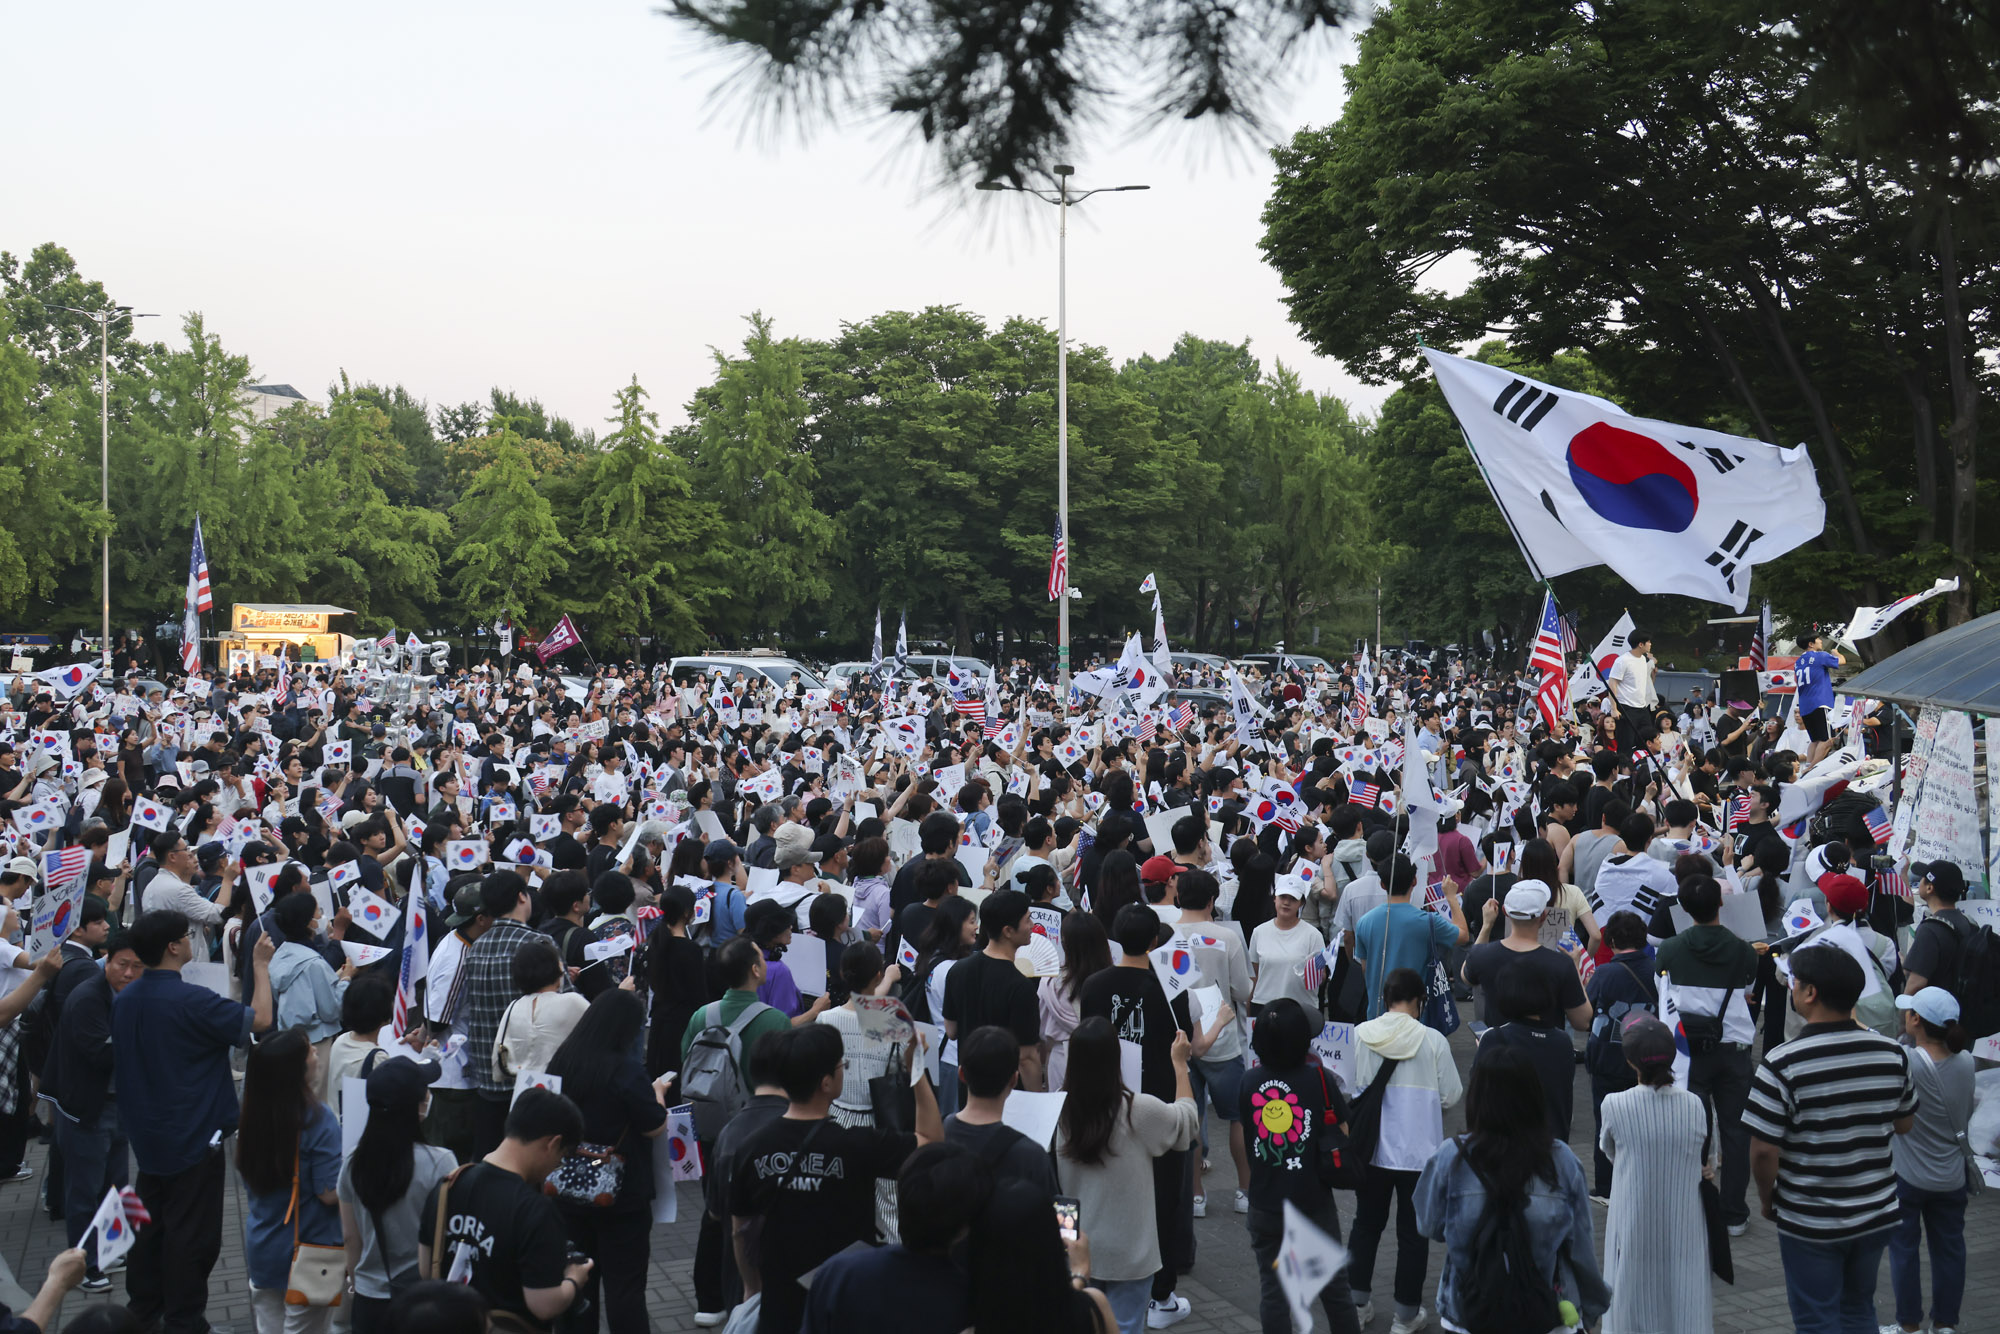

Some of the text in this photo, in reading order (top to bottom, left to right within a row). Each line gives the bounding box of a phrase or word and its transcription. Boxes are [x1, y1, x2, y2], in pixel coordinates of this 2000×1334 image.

[1796, 666, 1811, 687] 21
[1030, 911, 1053, 925] OREA
[446, 1214, 495, 1257] OREA
